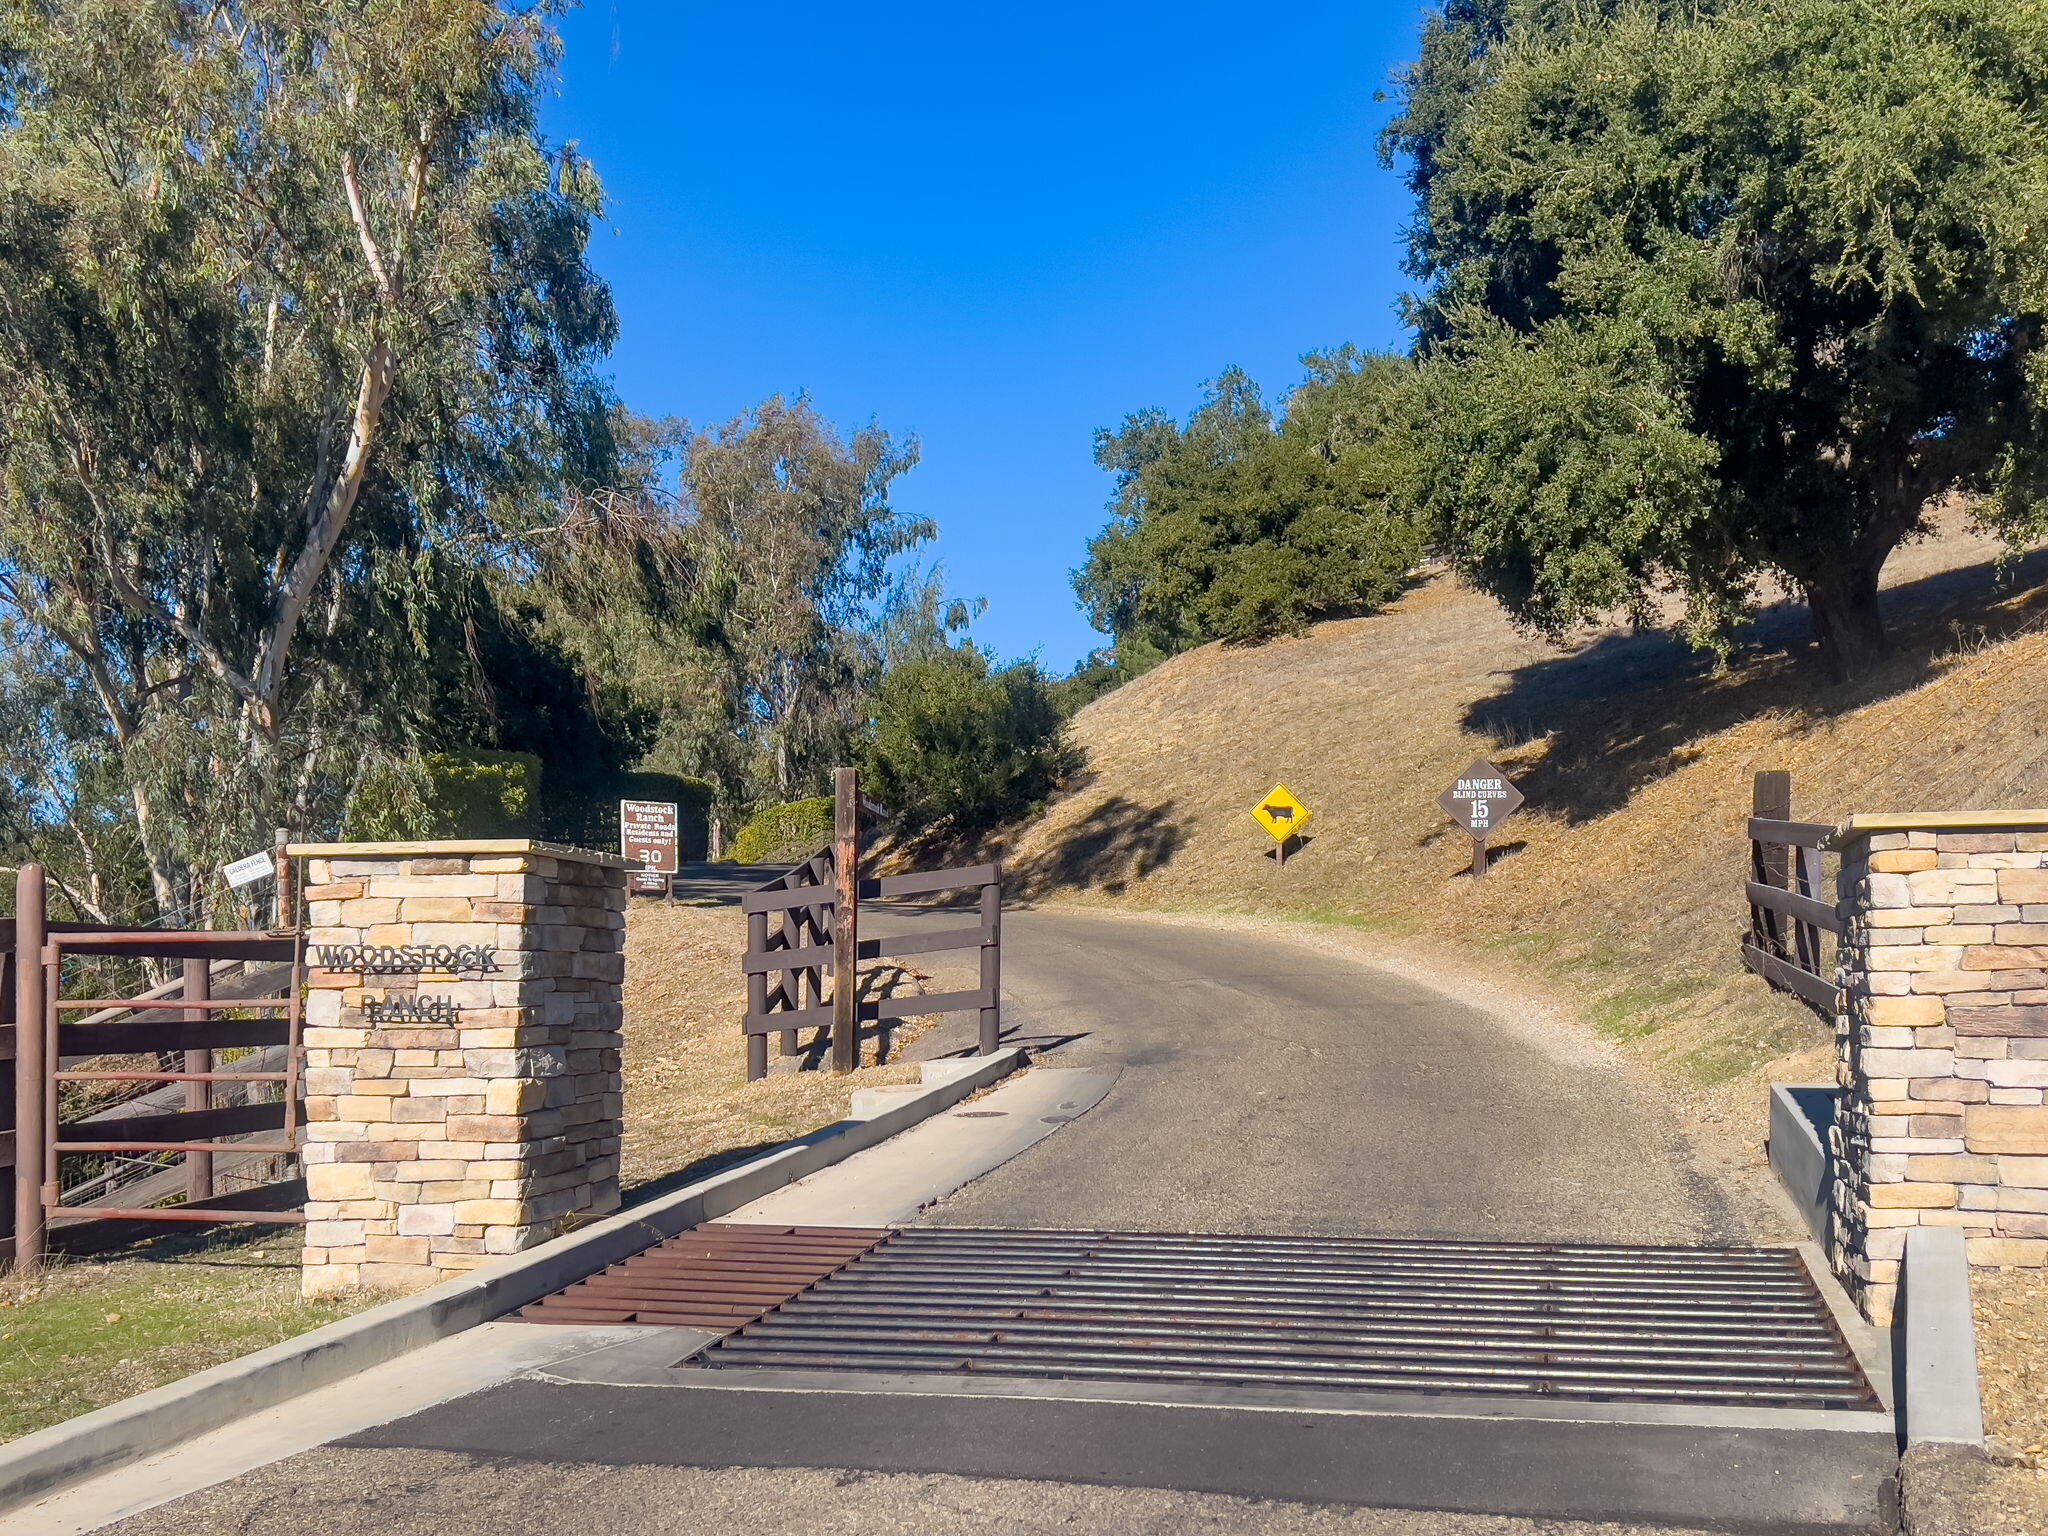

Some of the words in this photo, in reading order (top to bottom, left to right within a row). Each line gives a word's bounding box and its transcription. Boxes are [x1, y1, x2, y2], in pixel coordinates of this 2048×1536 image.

[1457, 779, 1502, 790] DANGER
[1453, 791, 1476, 799] BLIND
[1477, 791, 1508, 799] CURVES
[626, 803, 674, 814] Woodstock
[1470, 800, 1489, 818] 15
[636, 813, 664, 822] Ranch
[624, 821, 652, 830] Private
[654, 823, 677, 831] Roads
[1470, 820, 1489, 828] MPH
[626, 829, 659, 837] Residents
[629, 836, 652, 844] Guests
[652, 838, 672, 846] only!
[639, 849, 662, 863] 30
[316, 944, 499, 968] WOODSTOCK
[360, 994, 452, 1018] RANCH
